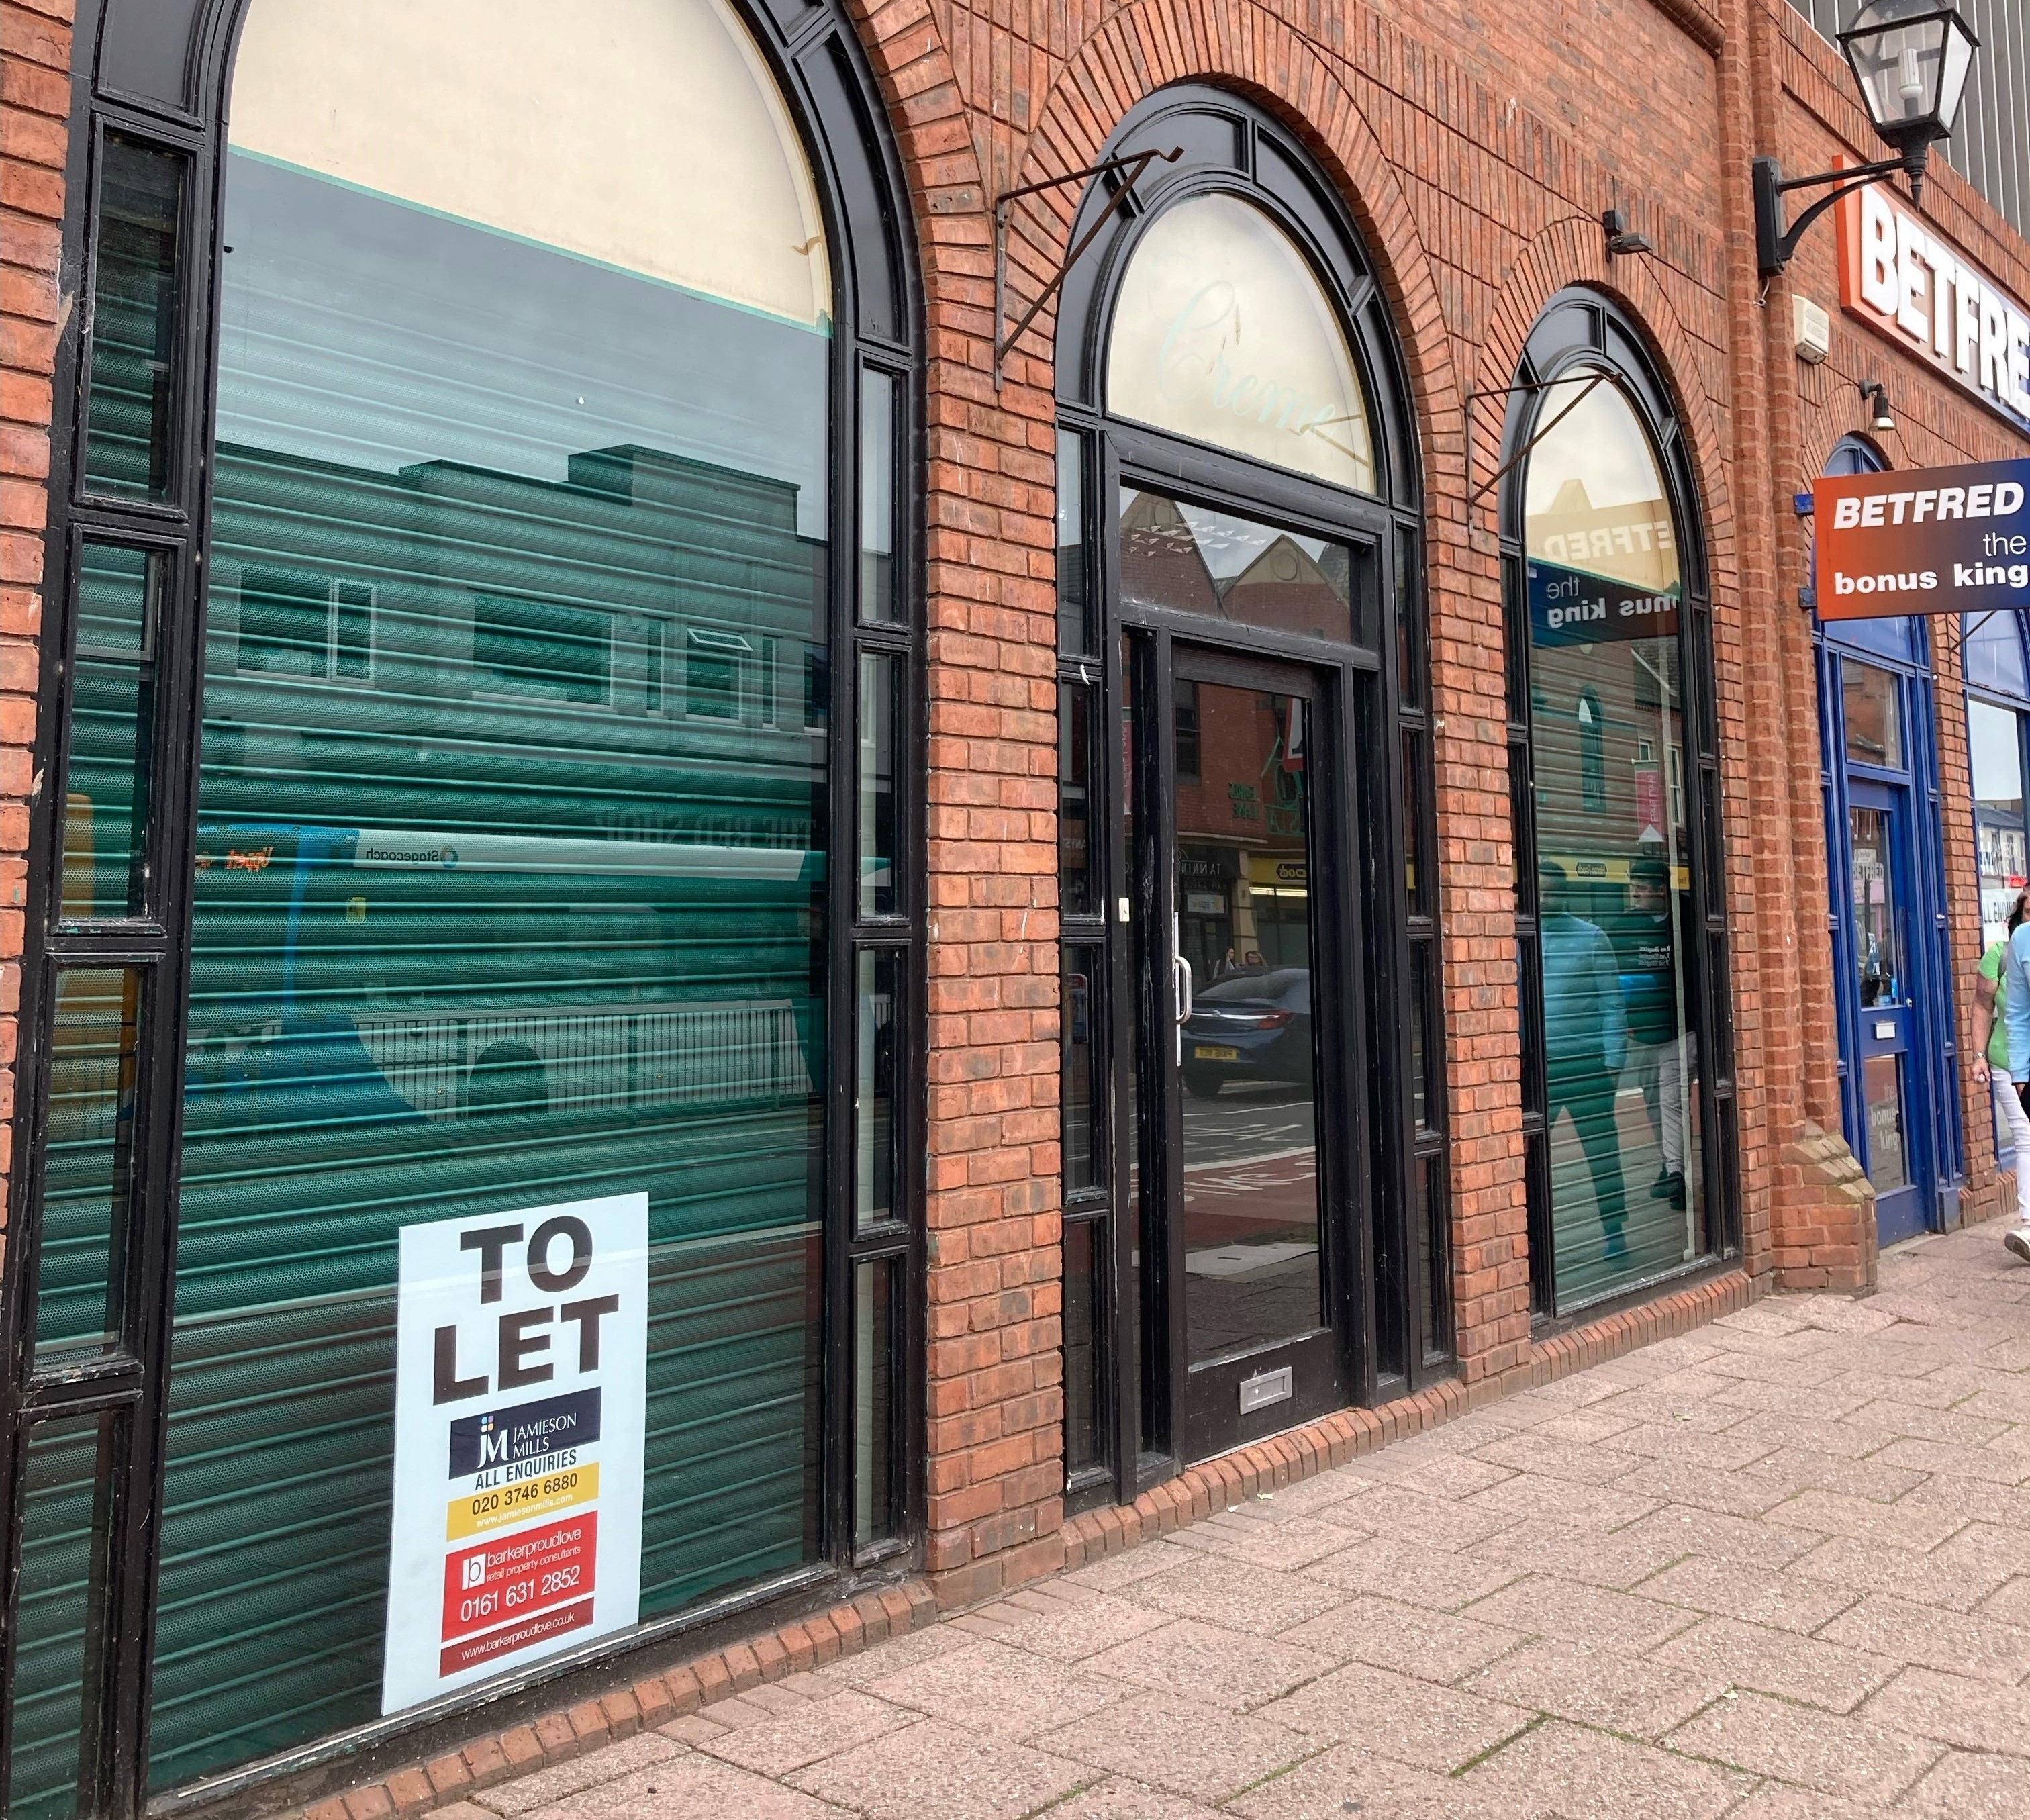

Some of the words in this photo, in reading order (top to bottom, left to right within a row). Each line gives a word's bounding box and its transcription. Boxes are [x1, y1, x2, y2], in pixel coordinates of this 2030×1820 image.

[1833, 482, 2025, 530] BETFRED
[1982, 532, 2027, 557] the
[1835, 571, 1938, 595] bonus
[1953, 561, 2029, 589] king
[460, 1216, 593, 1304] TO
[433, 1294, 620, 1406] LET
[512, 1412, 577, 1444] JAMIESON
[512, 1437, 550, 1459] MILLS
[475, 1469, 501, 1492] ALL
[506, 1449, 577, 1482] ENQUIRIES
[472, 1494, 499, 1515] 020
[504, 1483, 538, 1506] 3746
[544, 1472, 577, 1495] 6880
[476, 1494, 573, 1528] www.jamiesonmills.com
[486, 1568, 505, 1583] retail
[506, 1559, 538, 1578] property
[540, 1545, 581, 1566] consultants
[487, 1528, 582, 1568] barkerproudlove
[461, 1590, 499, 1623] 0161
[505, 1578, 534, 1607] 631
[540, 1565, 581, 1596] 2852
[461, 1612, 575, 1660] www.barkerproudlove.co.uk
